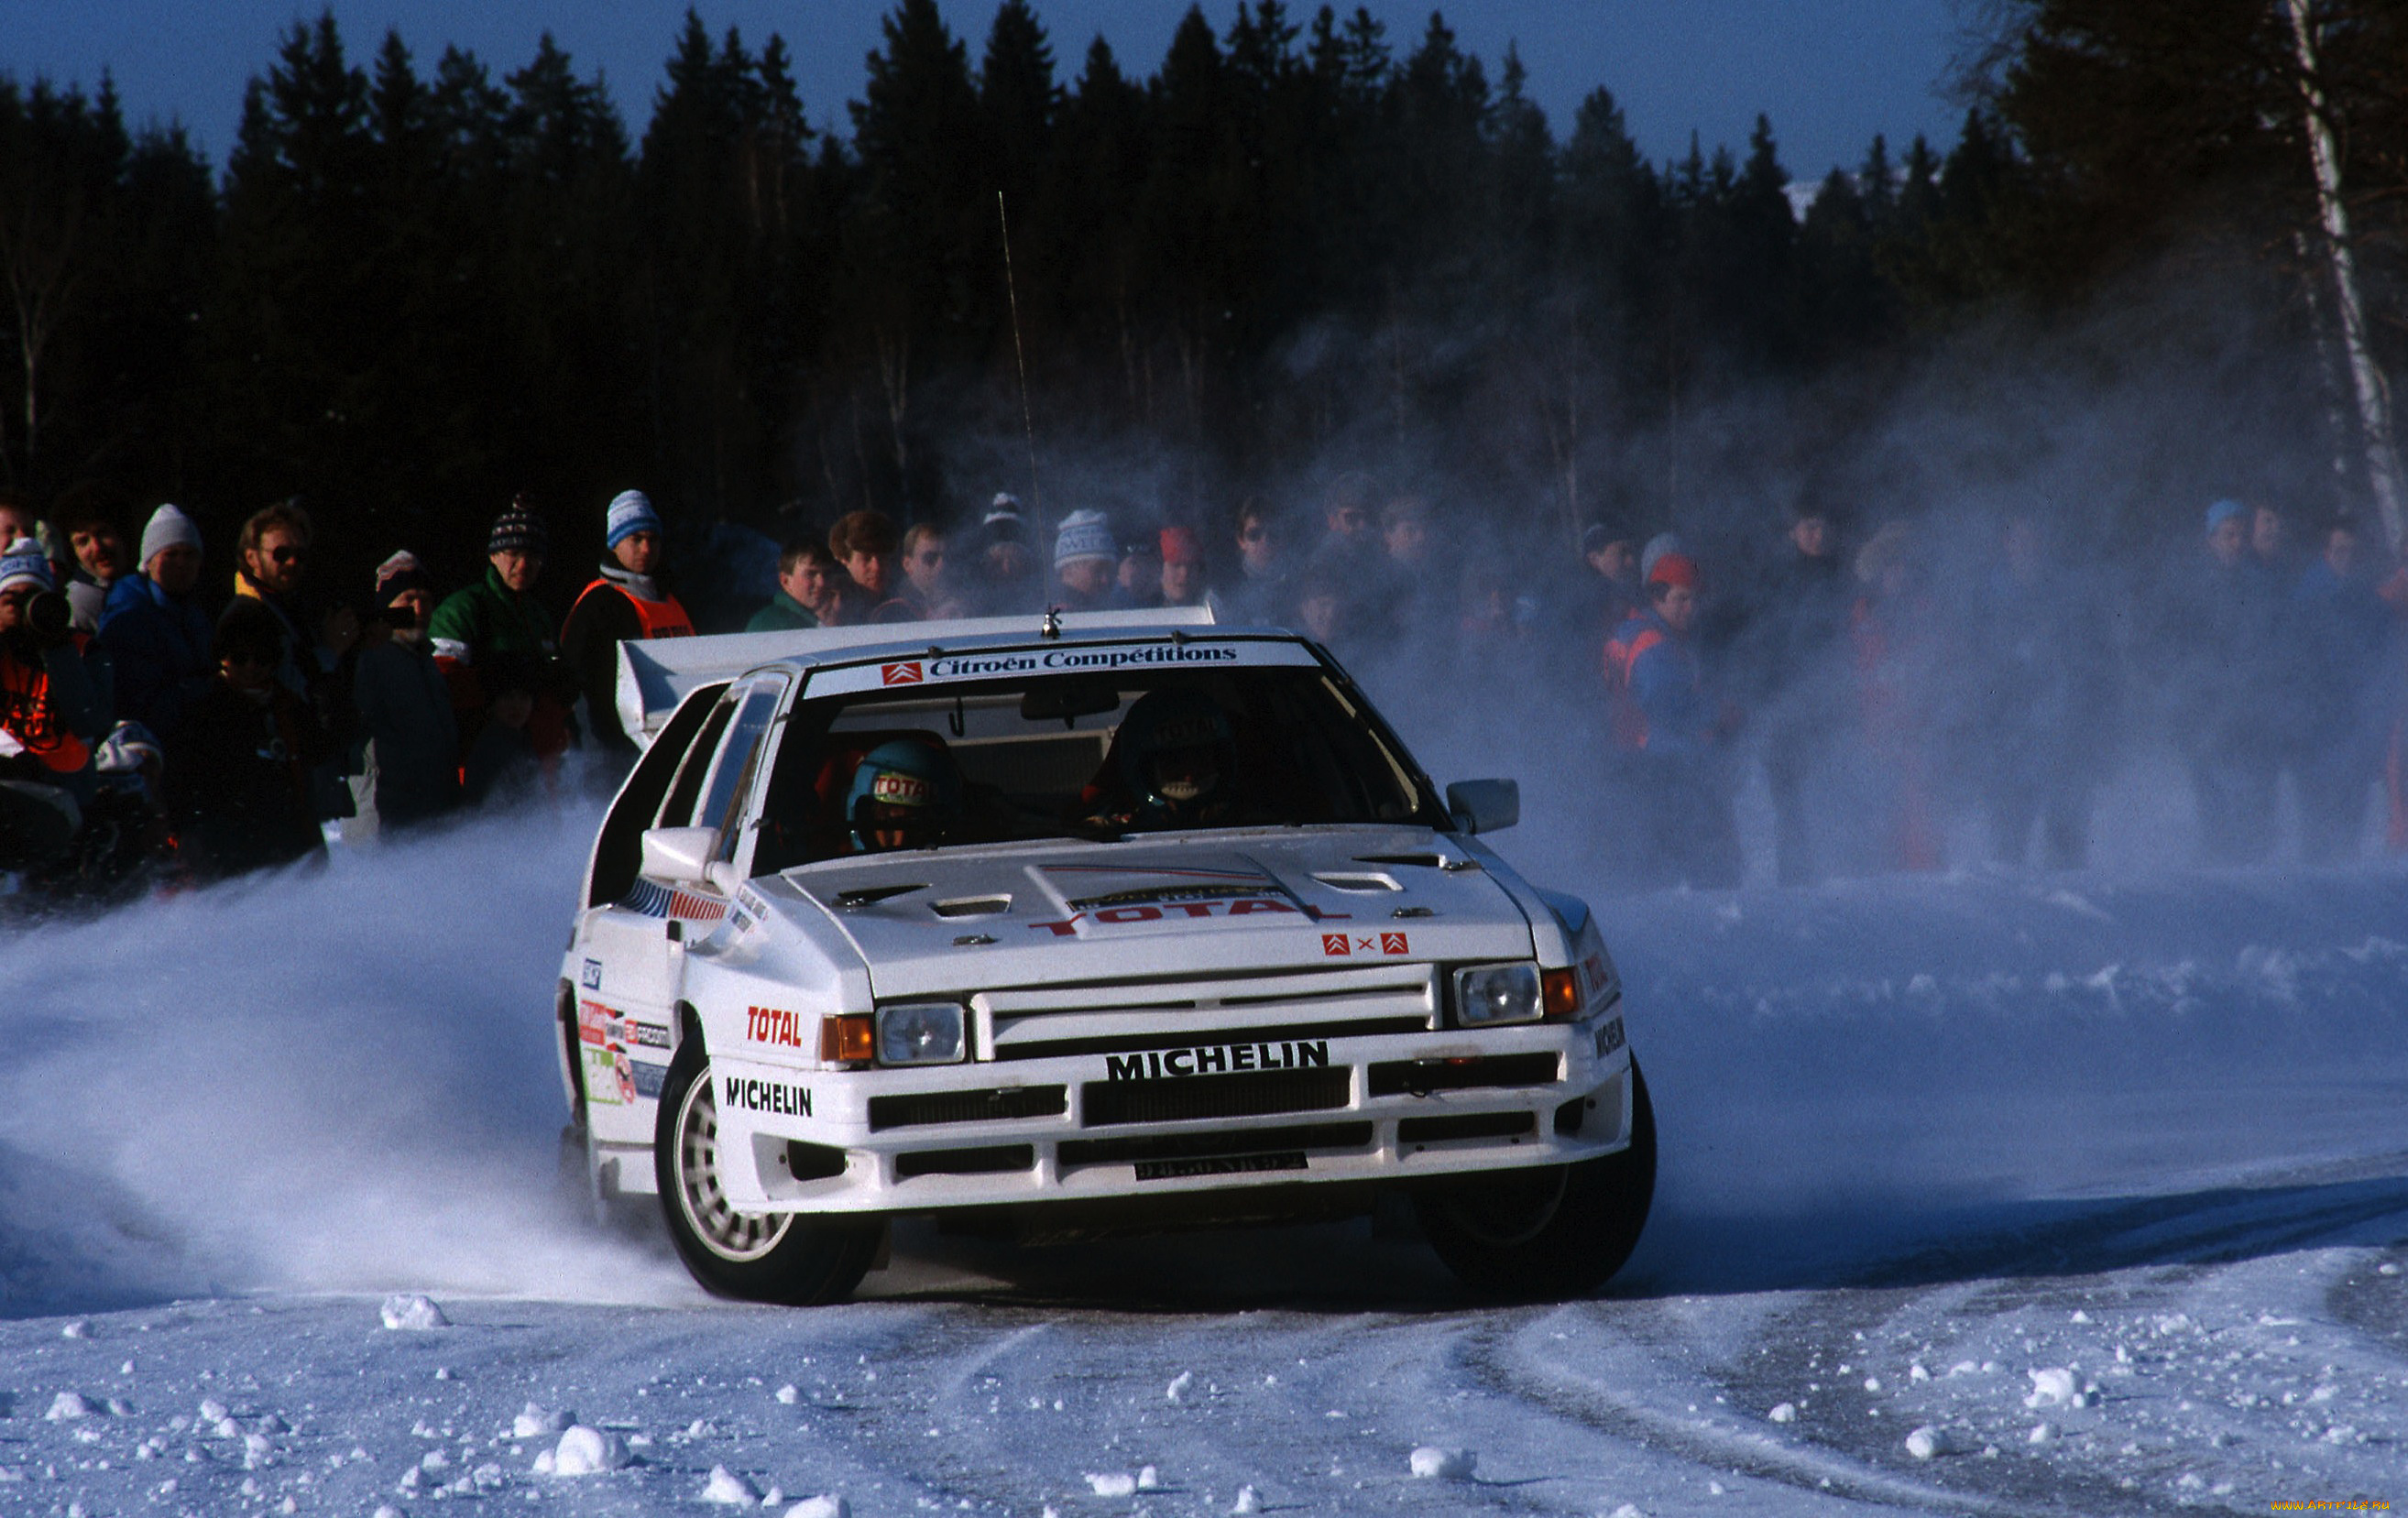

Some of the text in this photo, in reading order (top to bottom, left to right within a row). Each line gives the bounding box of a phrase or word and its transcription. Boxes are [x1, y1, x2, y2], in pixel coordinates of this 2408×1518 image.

[929, 646, 1237, 676] Citroën Compétitions
[1028, 899, 1353, 936] TOTAL
[747, 1006, 802, 1047] TOTAL
[1106, 1041, 1329, 1081] MICHELIN
[727, 1076, 812, 1117] MICHELIN
